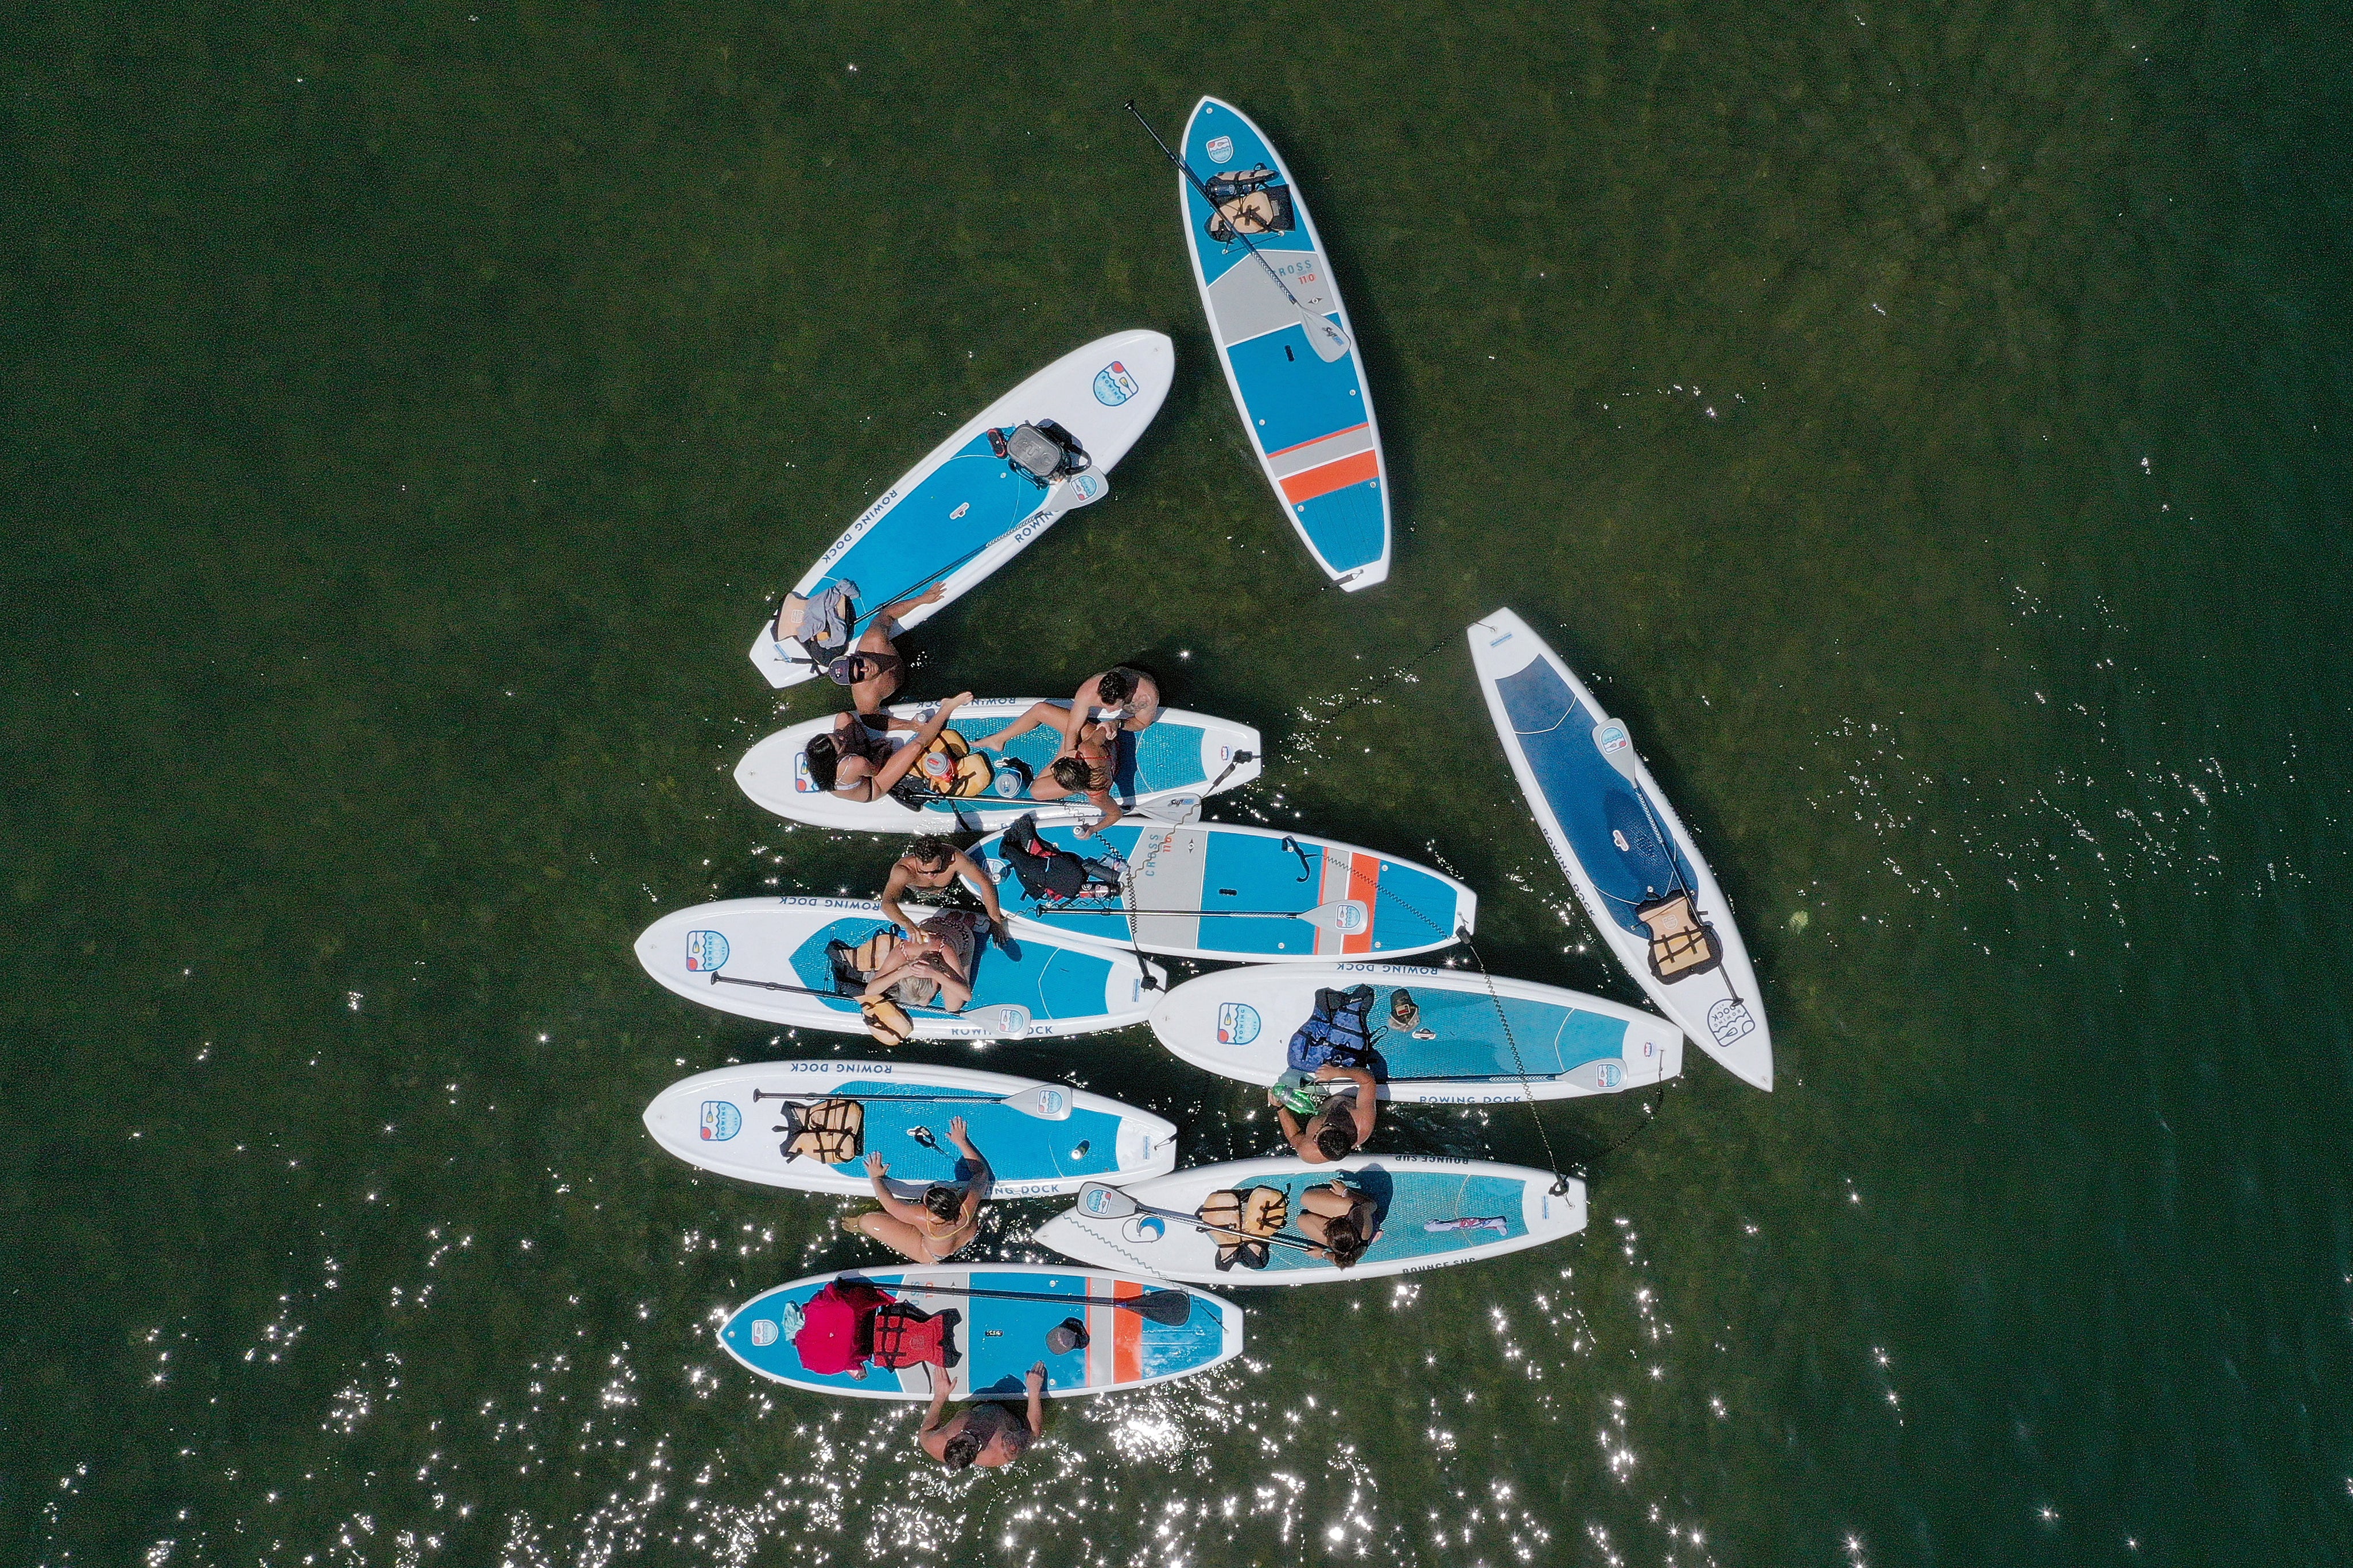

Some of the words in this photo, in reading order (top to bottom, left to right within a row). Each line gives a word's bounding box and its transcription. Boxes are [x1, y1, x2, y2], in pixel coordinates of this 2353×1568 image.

[1273, 259, 1312, 277] ROSS
[1298, 273, 1316, 285] 110
[1102, 375, 1121, 400] ROWING
[855, 490, 898, 531] ROWING
[1014, 510, 1059, 543] ROWIN
[822, 533, 853, 564] DOCK
[1146, 834, 1159, 877] CROSS
[1542, 828, 1572, 878] ROWING
[1573, 884, 1595, 917] DOCK
[779, 897, 818, 906] DOCK
[824, 899, 881, 911] ROWING
[1336, 963, 1374, 972] DOCK
[1382, 965, 1439, 975] ROWING
[1711, 1005, 1736, 1022] DOCK
[1714, 1009, 1741, 1028] ROWING
[951, 1028, 991, 1036] ROWI
[1027, 1026, 1054, 1034] OCK
[790, 1063, 829, 1072] DOCK
[836, 1064, 892, 1073] ROWING
[1422, 1155, 1469, 1165] BOUNCE
[1021, 1184, 1059, 1195] DOCK
